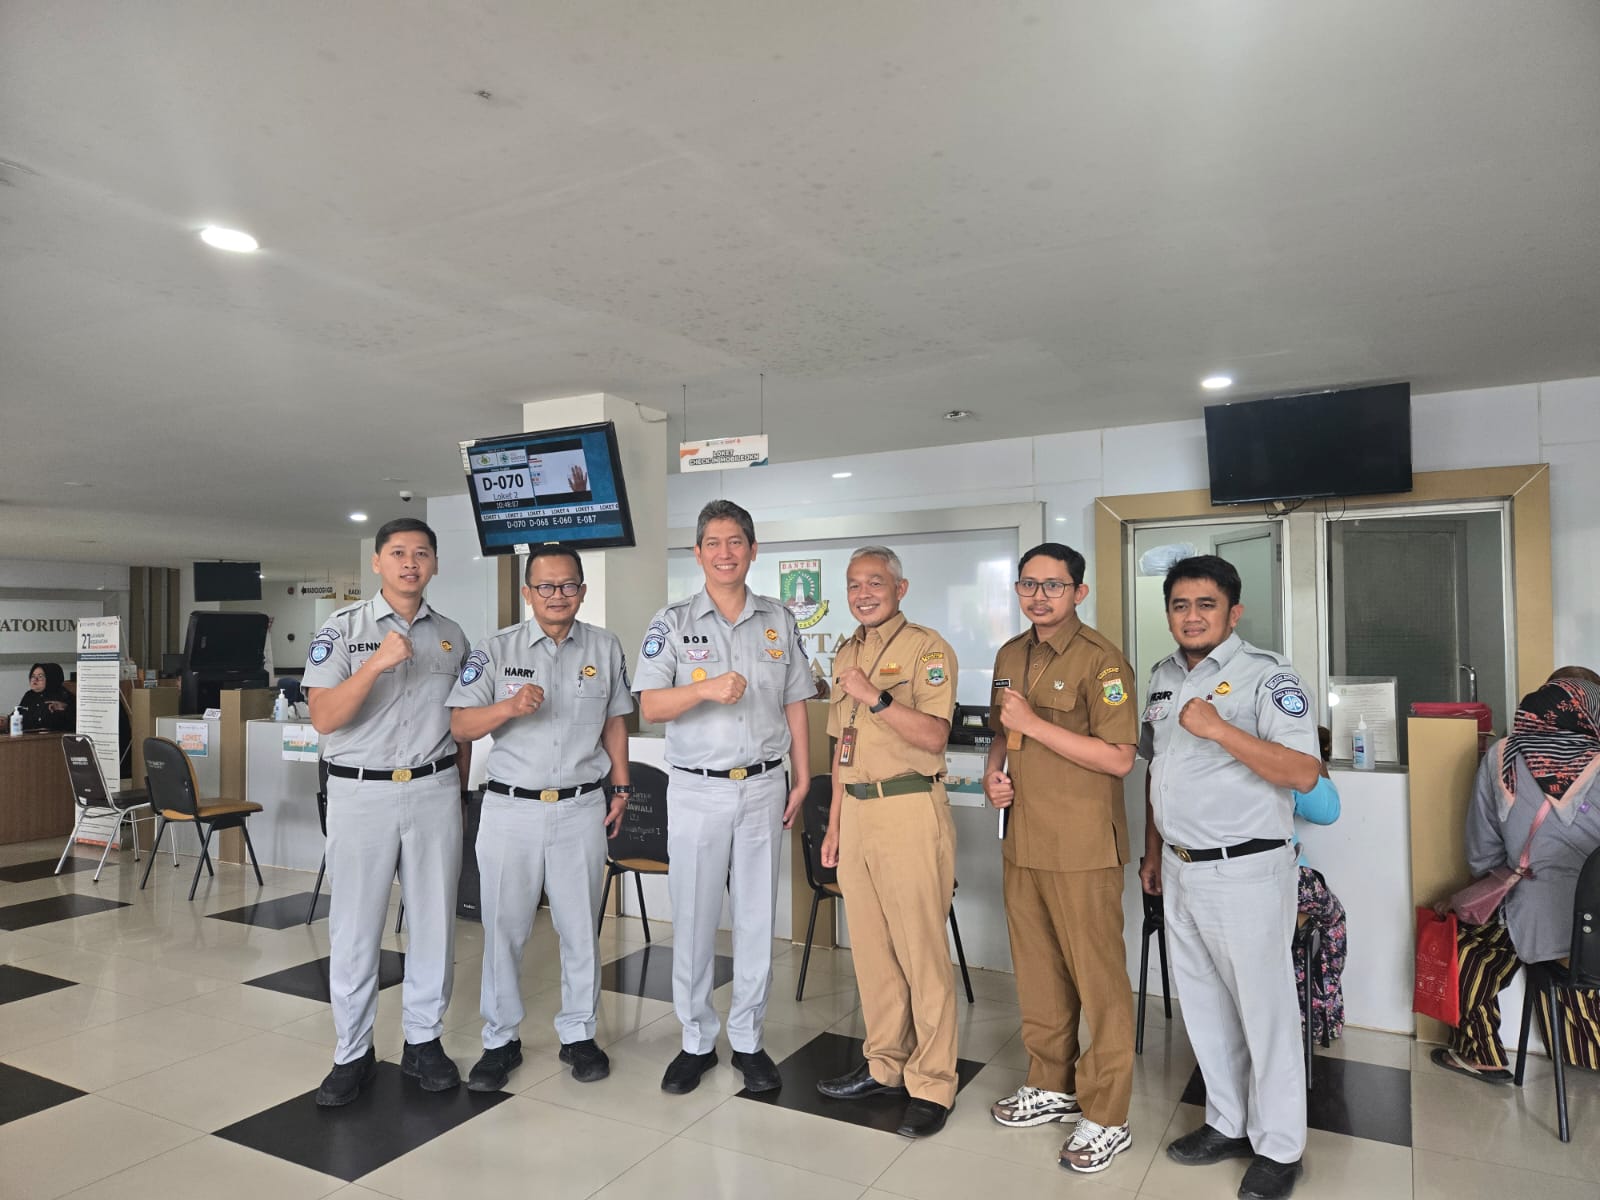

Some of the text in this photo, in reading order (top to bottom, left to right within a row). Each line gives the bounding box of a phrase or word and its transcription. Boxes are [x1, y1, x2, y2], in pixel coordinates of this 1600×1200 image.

[482, 473, 523, 491] D-070
[493, 491, 519, 500] Loket 2
[506, 521, 527, 529] D-070
[504, 667, 535, 679] HARRY
